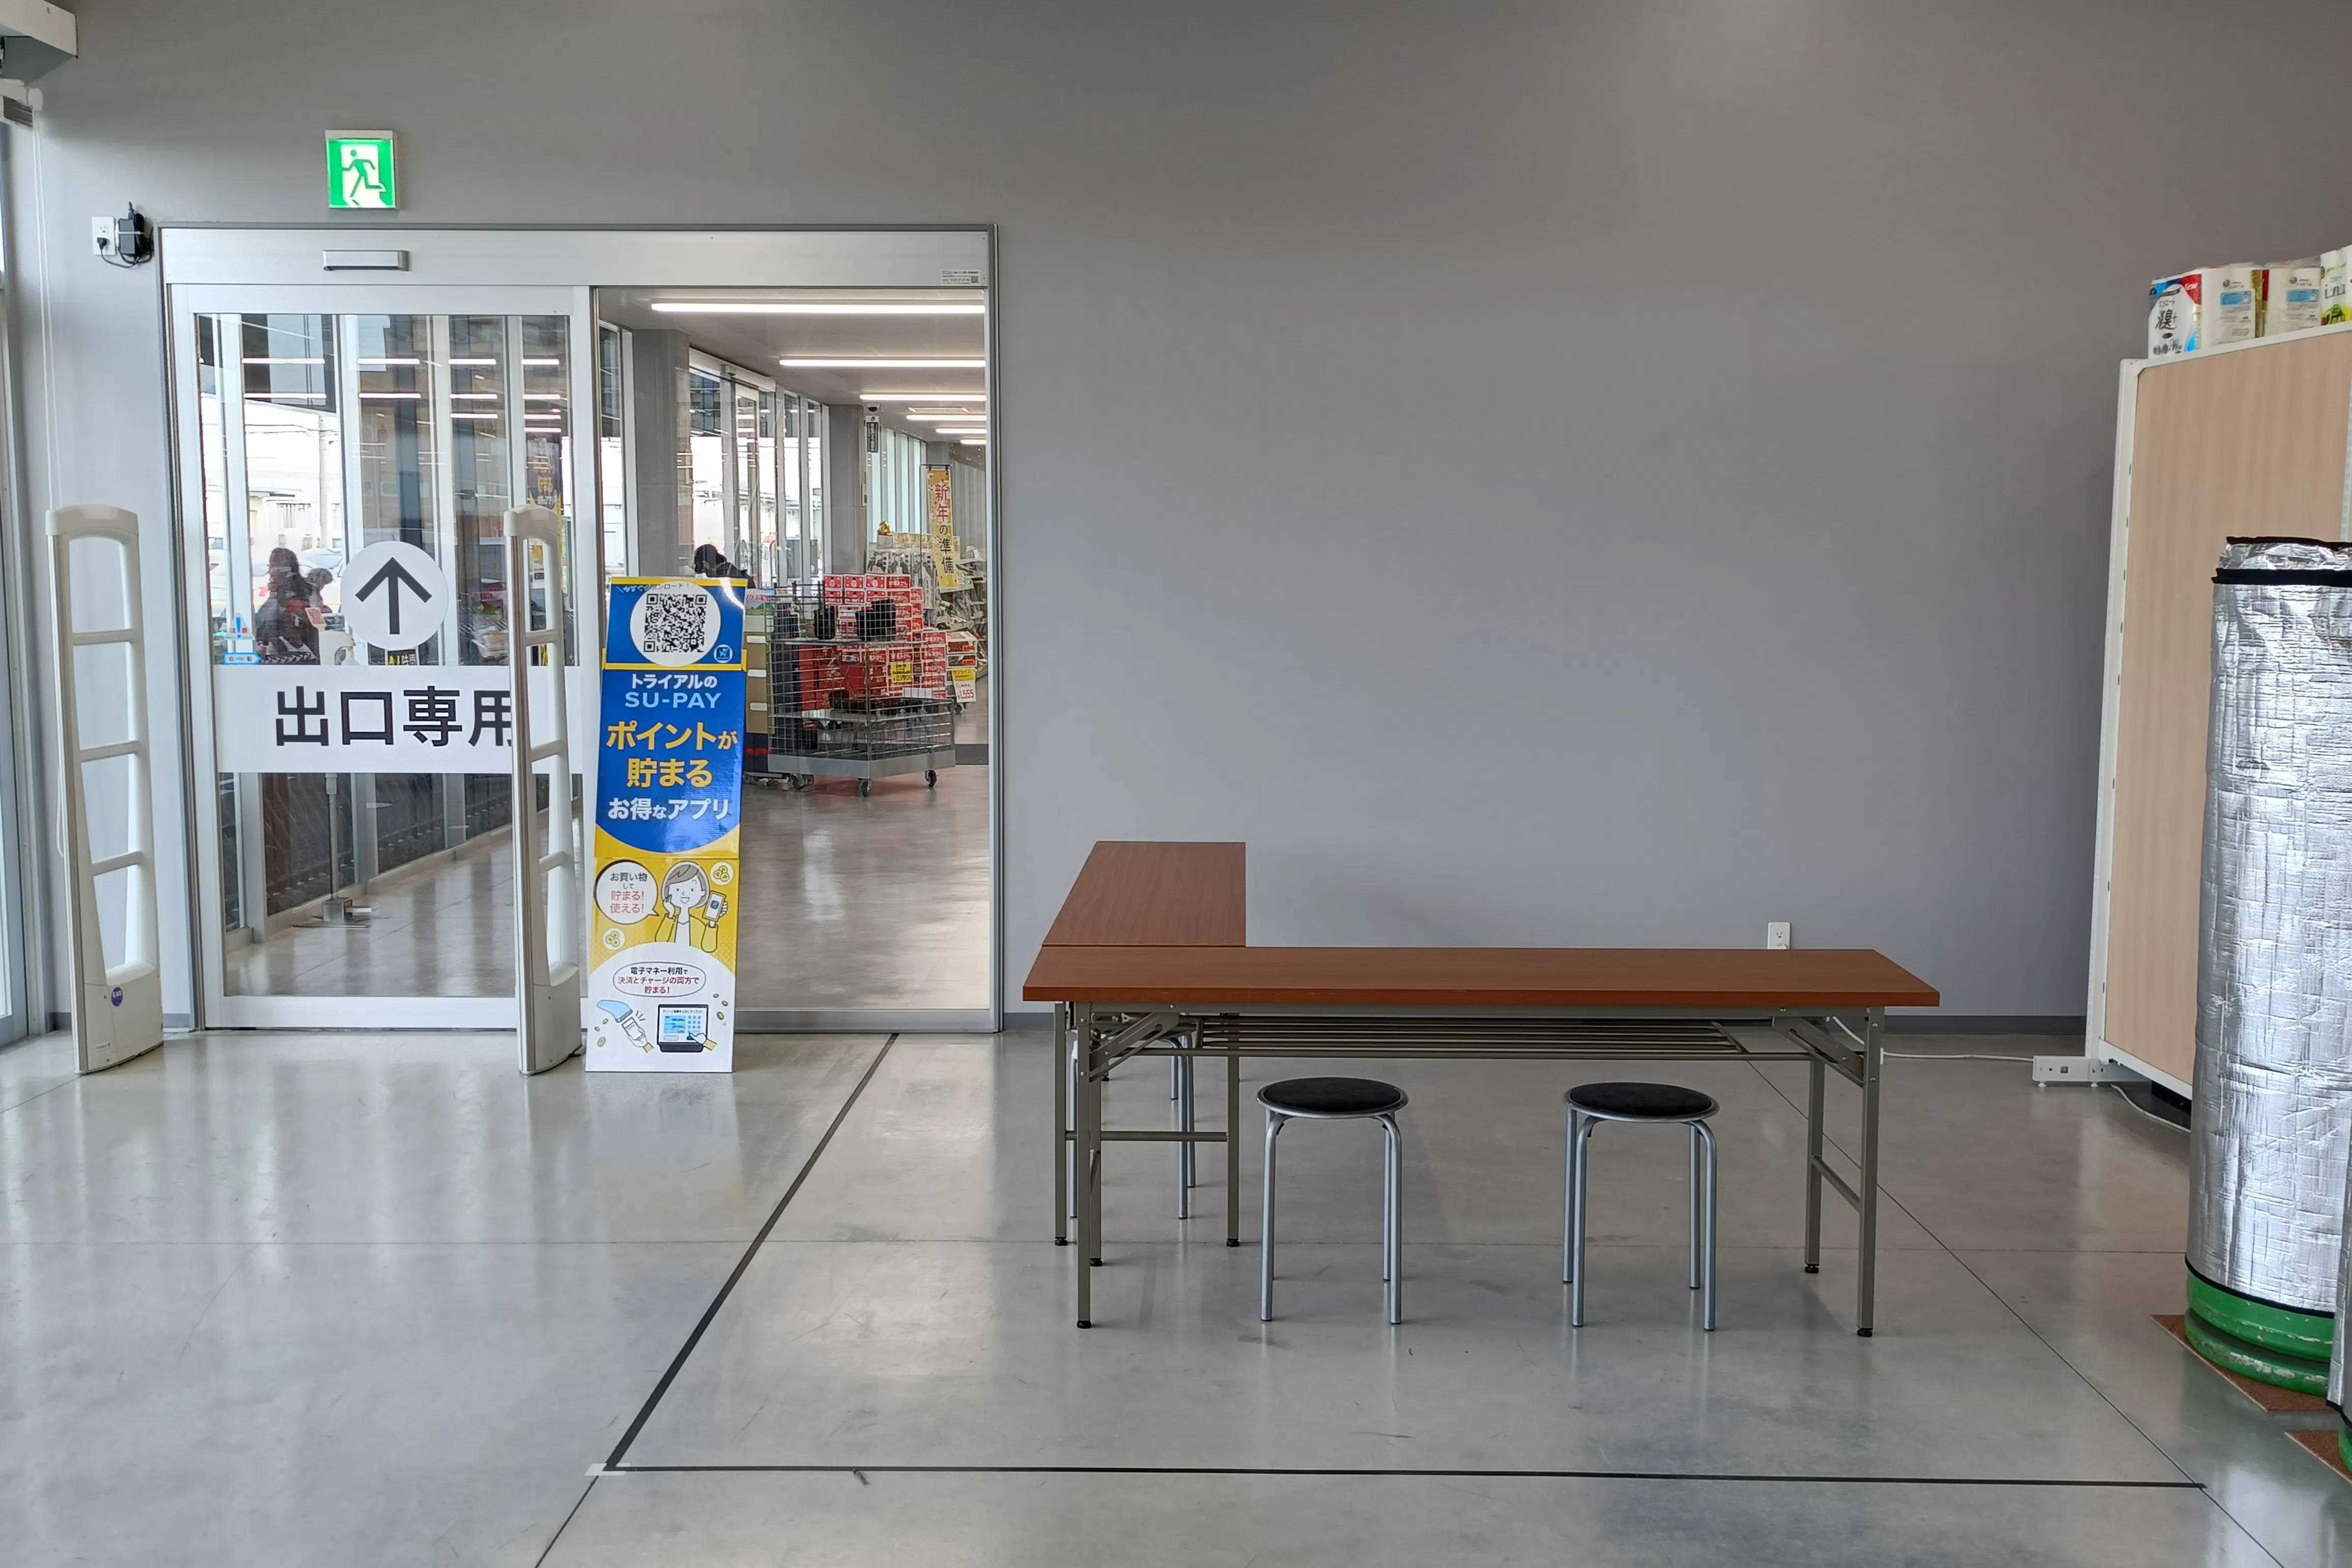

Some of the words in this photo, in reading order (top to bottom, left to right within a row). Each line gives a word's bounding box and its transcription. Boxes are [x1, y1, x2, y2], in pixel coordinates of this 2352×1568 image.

[935, 484, 954, 574] 新年の準備
[632, 674, 717, 689] トライアルの
[625, 692, 722, 708] SU-PAY
[276, 686, 512, 747] 出口専用
[606, 720, 738, 750] ポイントが
[626, 757, 713, 788] 貯まる
[608, 797, 728, 820] お得なアプリ
[610, 872, 648, 882] お買い物
[610, 891, 644, 901] 貯まる!
[610, 903, 644, 913] 使える!
[630, 967, 688, 975] 電子マネー利用で
[618, 977, 700, 985] 決済とチャージの両方で
[644, 986, 670, 994] 貯まる!
